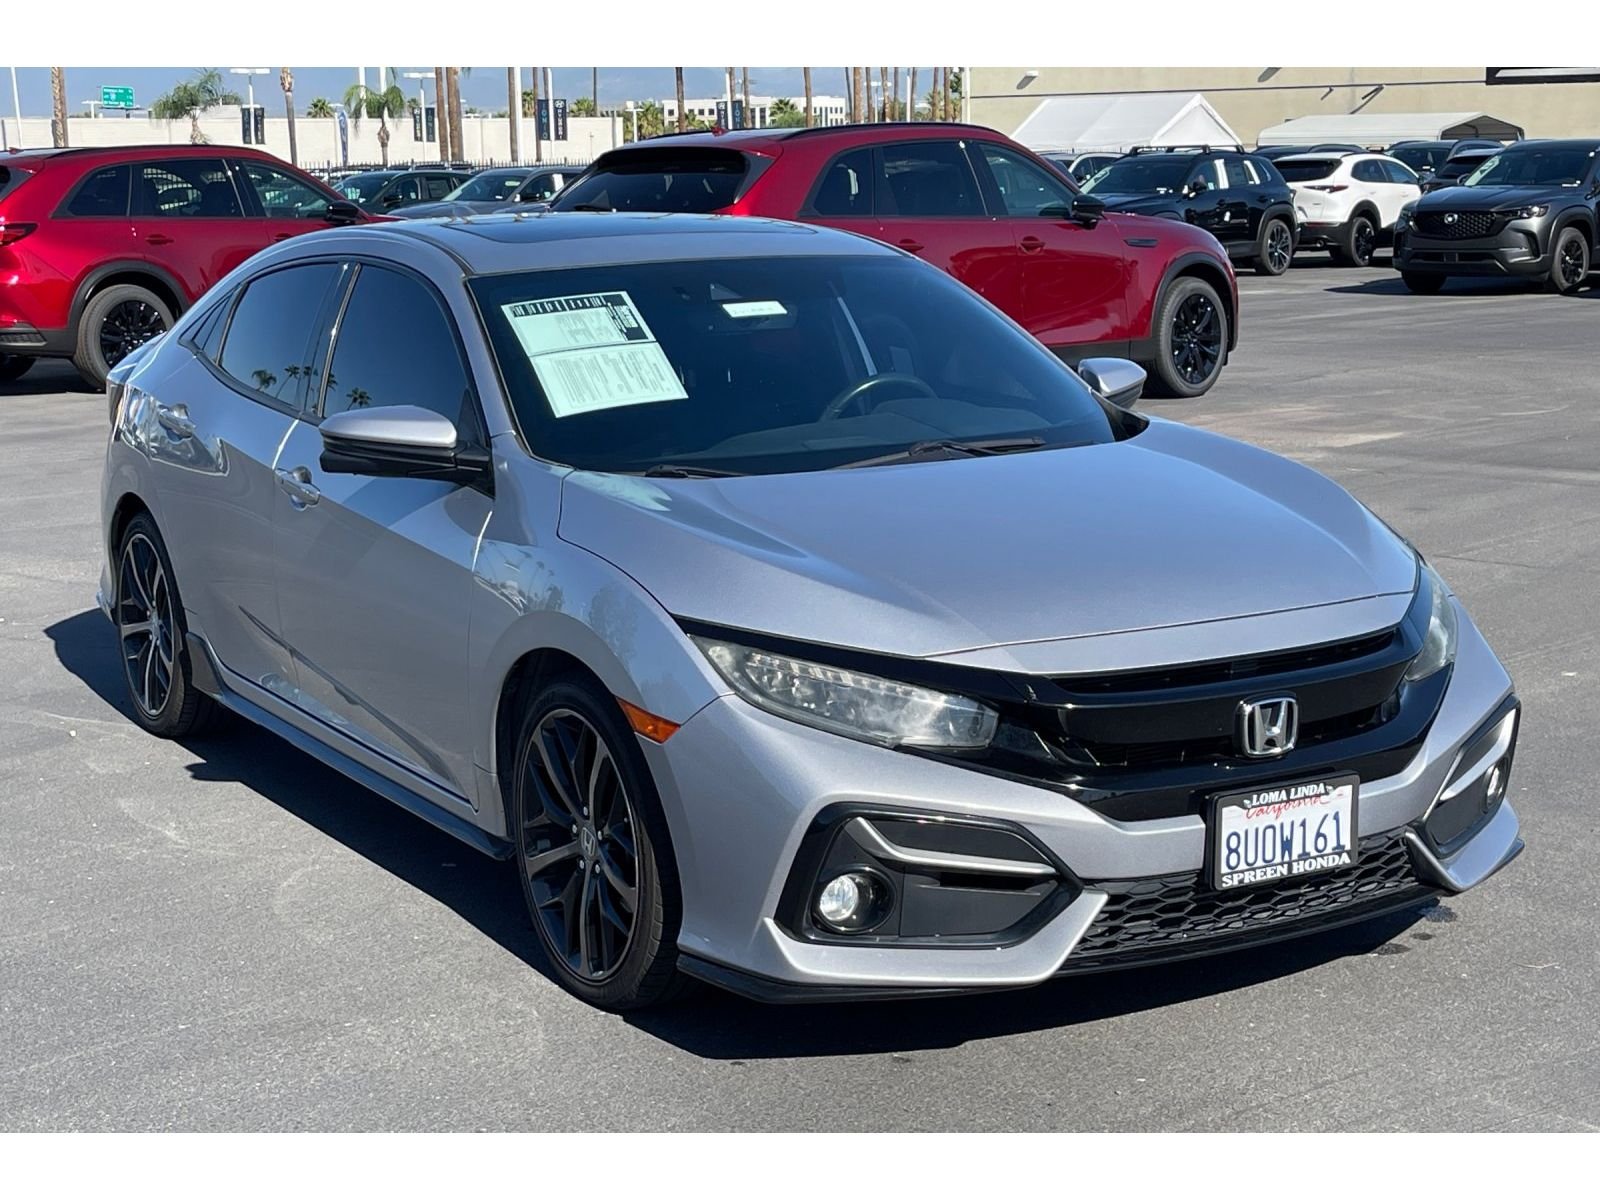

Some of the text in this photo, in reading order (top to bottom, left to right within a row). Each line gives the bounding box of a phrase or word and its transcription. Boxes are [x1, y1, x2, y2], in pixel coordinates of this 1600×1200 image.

[1252, 783, 1325, 806] LOMA LINDA
[1225, 810, 1346, 871] 8UOW161
[1221, 852, 1351, 888] SPREEN HONDA
